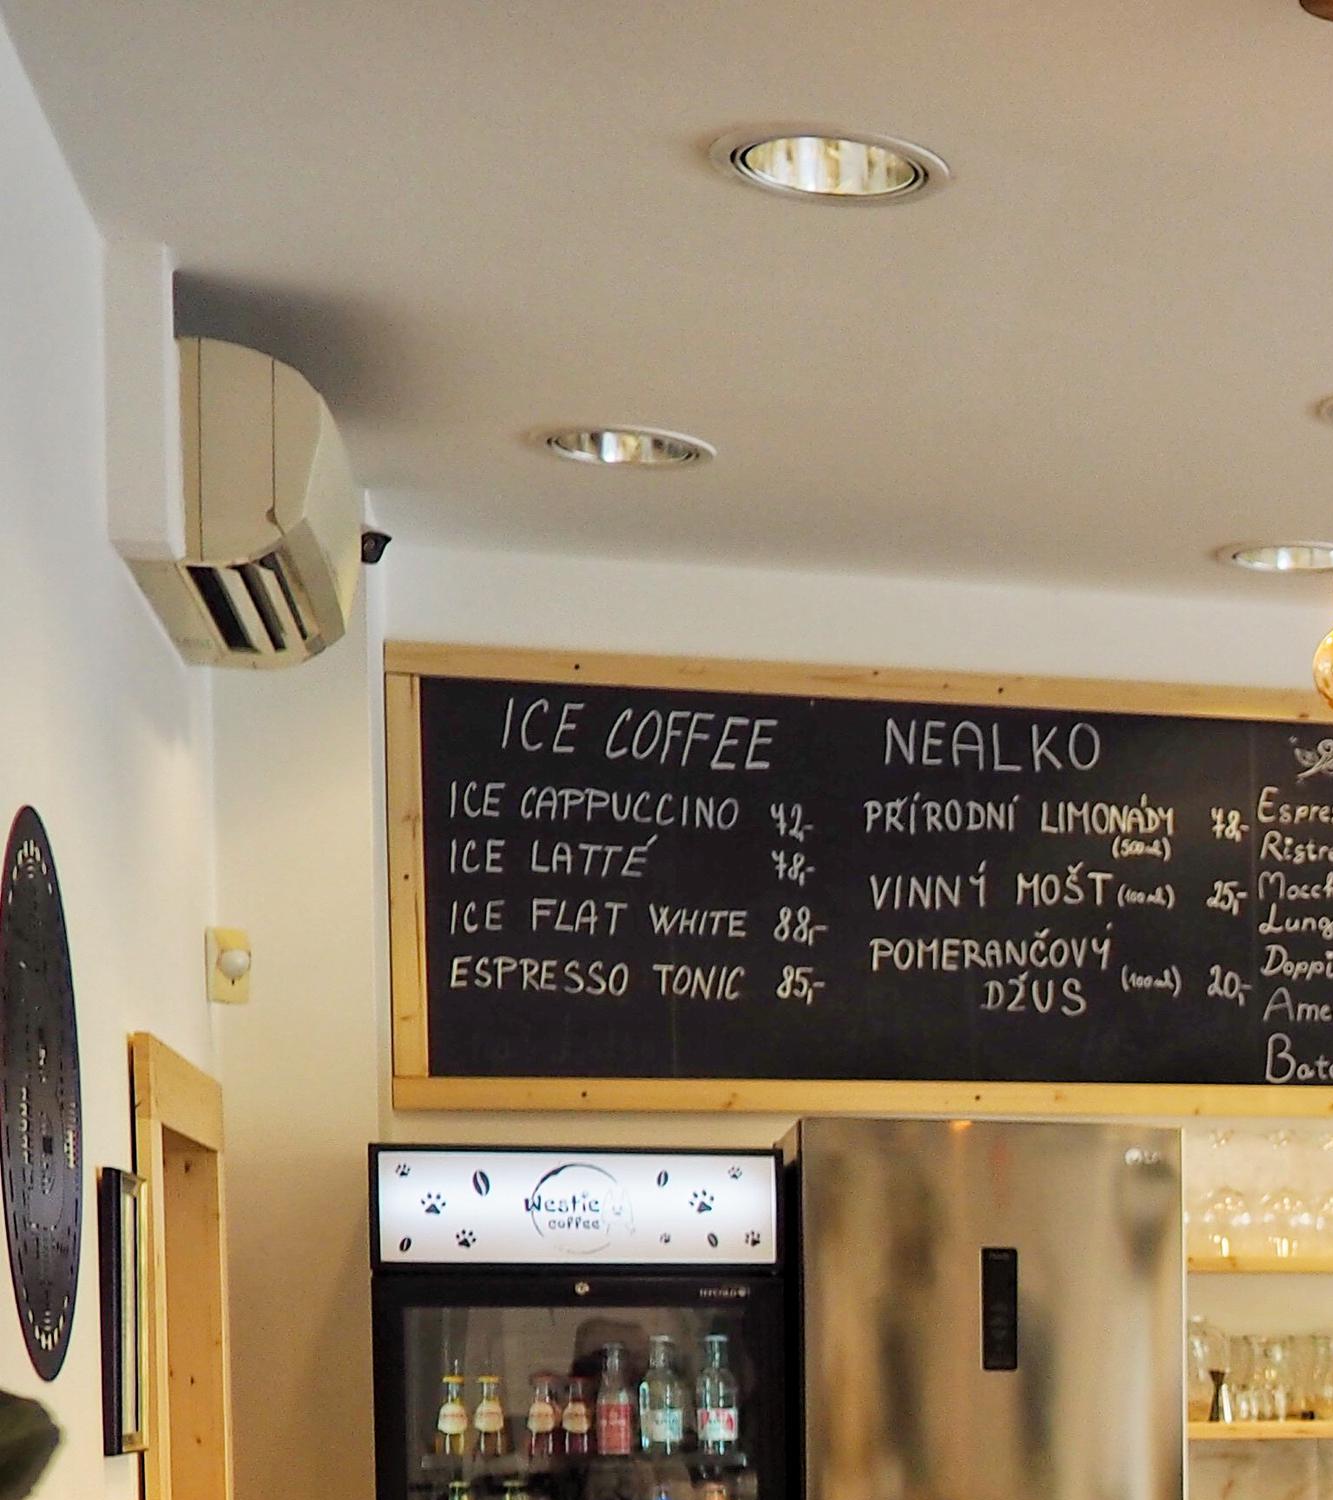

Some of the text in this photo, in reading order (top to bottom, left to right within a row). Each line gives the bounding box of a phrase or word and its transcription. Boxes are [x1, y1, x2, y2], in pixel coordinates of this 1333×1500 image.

[501, 698, 778, 770] ICE COFFEE
[884, 718, 1101, 772] NEALKO
[449, 781, 505, 818] ICE
[520, 787, 739, 830] CAPPUCCINO
[864, 792, 1020, 834] PŘÍRODNÍ
[1041, 793, 1175, 836] LIMONÁDY
[450, 839, 505, 873] ICE
[530, 834, 659, 878] LATTÉ
[870, 860, 988, 911] VINNÝ
[1016, 861, 1113, 906] MOŠT
[450, 900, 505, 934] ICE
[531, 898, 627, 936] FLAT
[649, 903, 748, 938] WHITE
[869, 922, 1113, 971] POMERANČOVÝ
[450, 955, 629, 997] ESPRESSO
[653, 964, 746, 1000] TONIC
[981, 970, 1087, 1017] DŽUS
[524, 1191, 600, 1213] Westie
[548, 1217, 600, 1231] coffee
